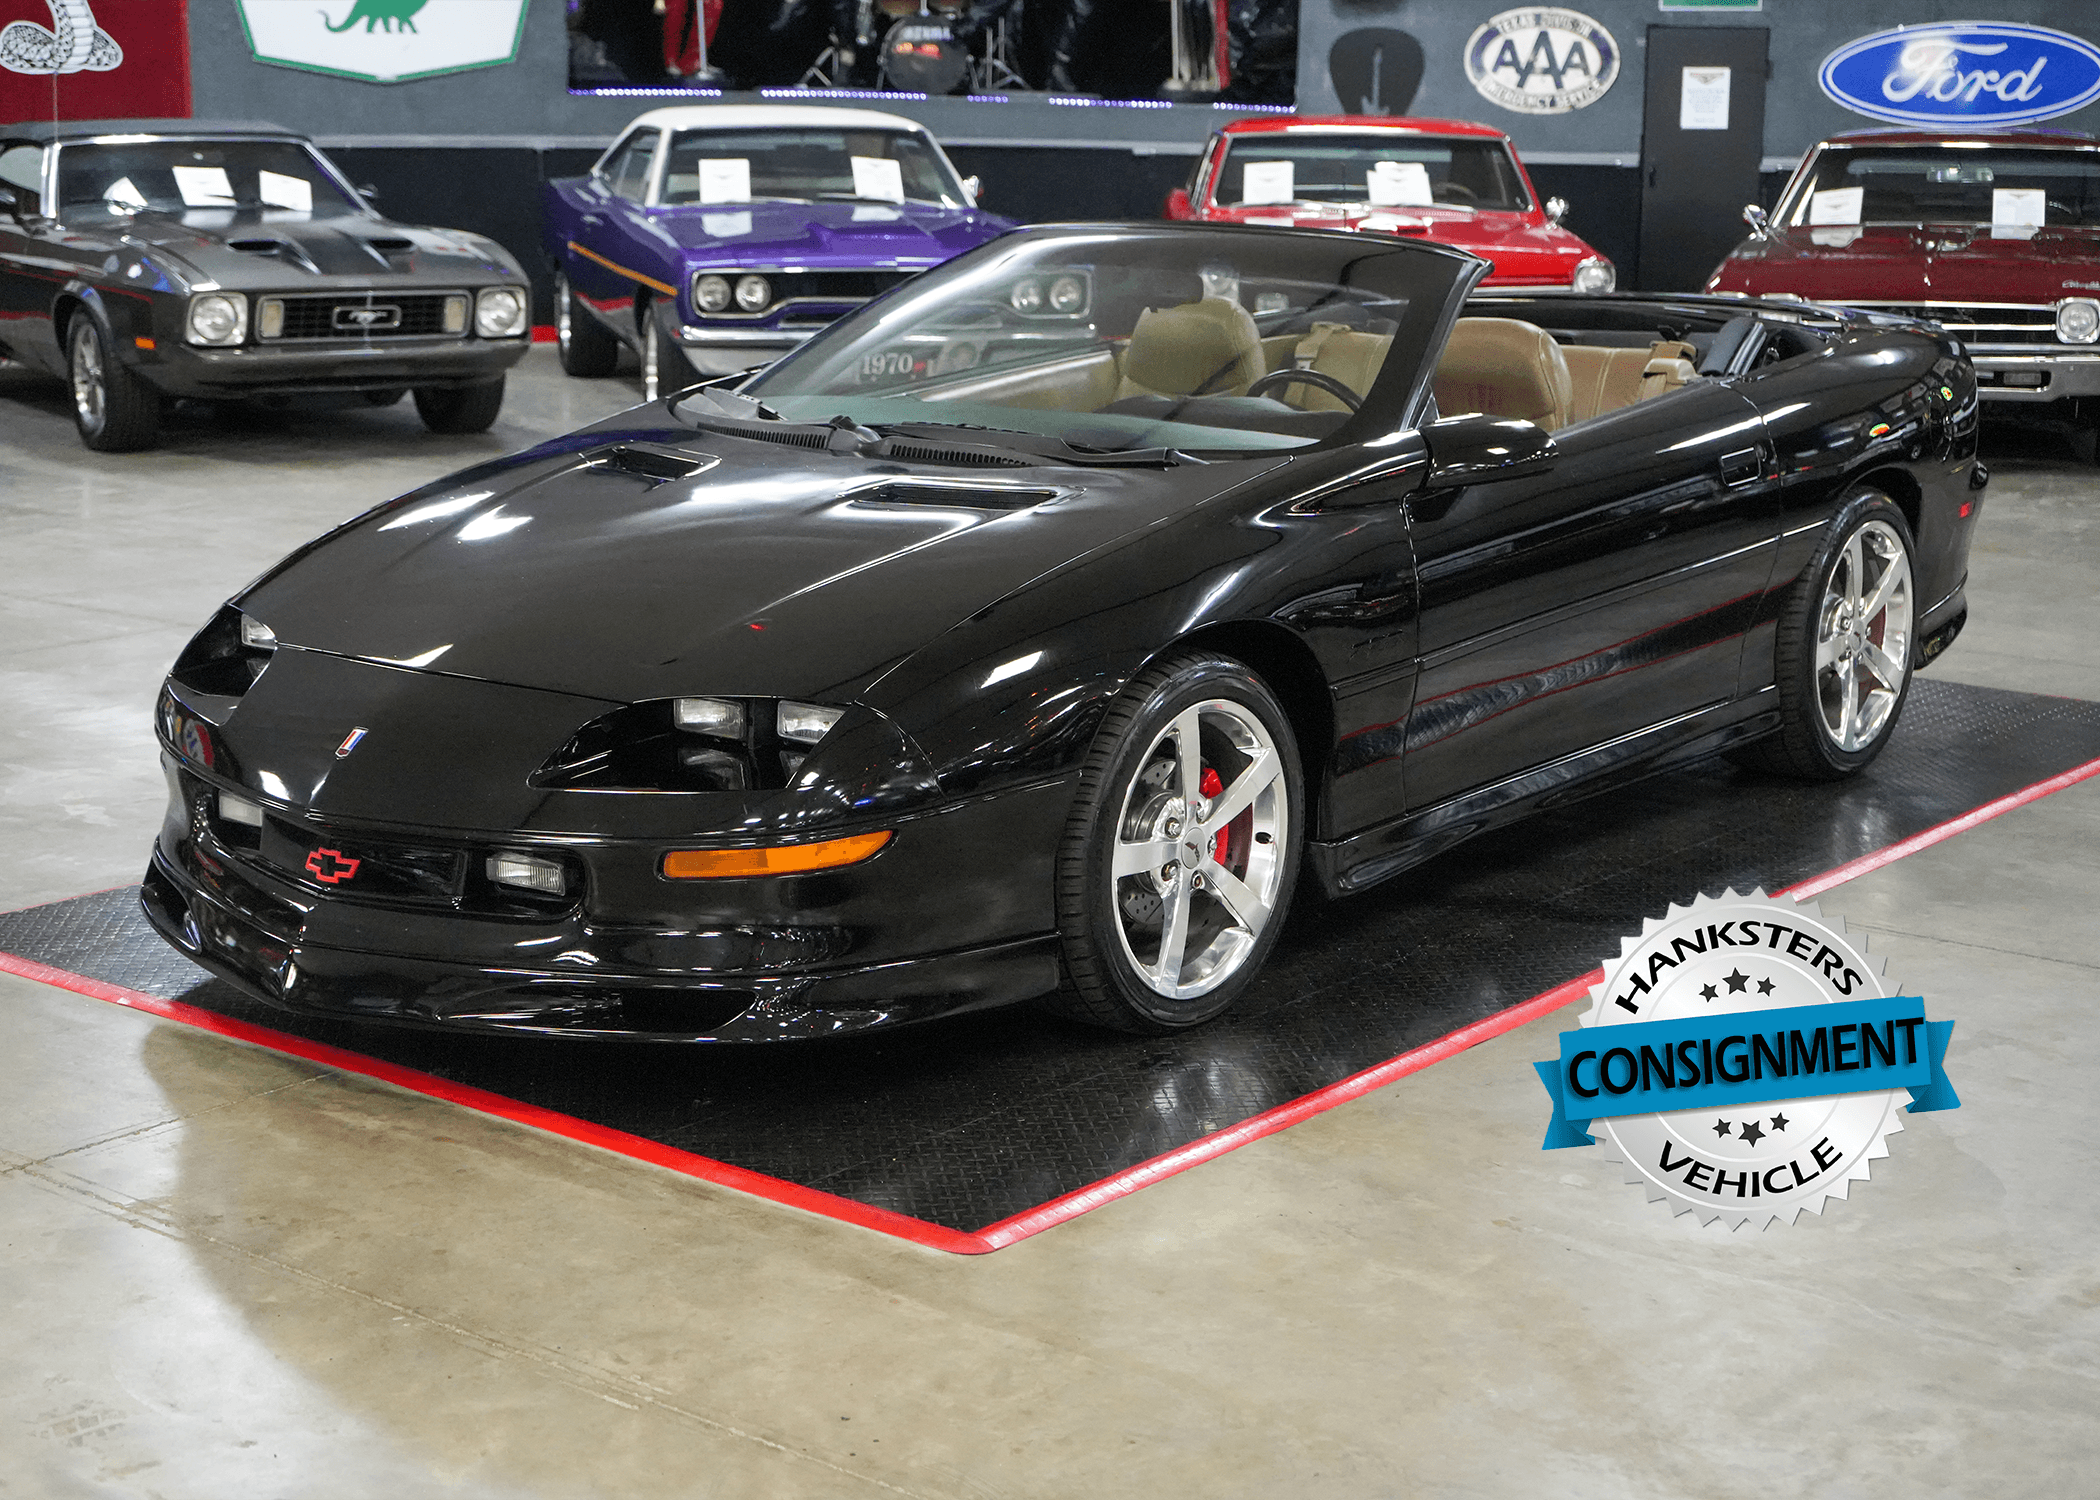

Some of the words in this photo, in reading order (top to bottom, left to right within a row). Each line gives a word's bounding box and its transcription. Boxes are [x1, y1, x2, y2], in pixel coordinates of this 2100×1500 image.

[1492, 30, 1591, 90] AAA
[1882, 39, 2048, 102] Ford
[862, 353, 913, 375] 1970
